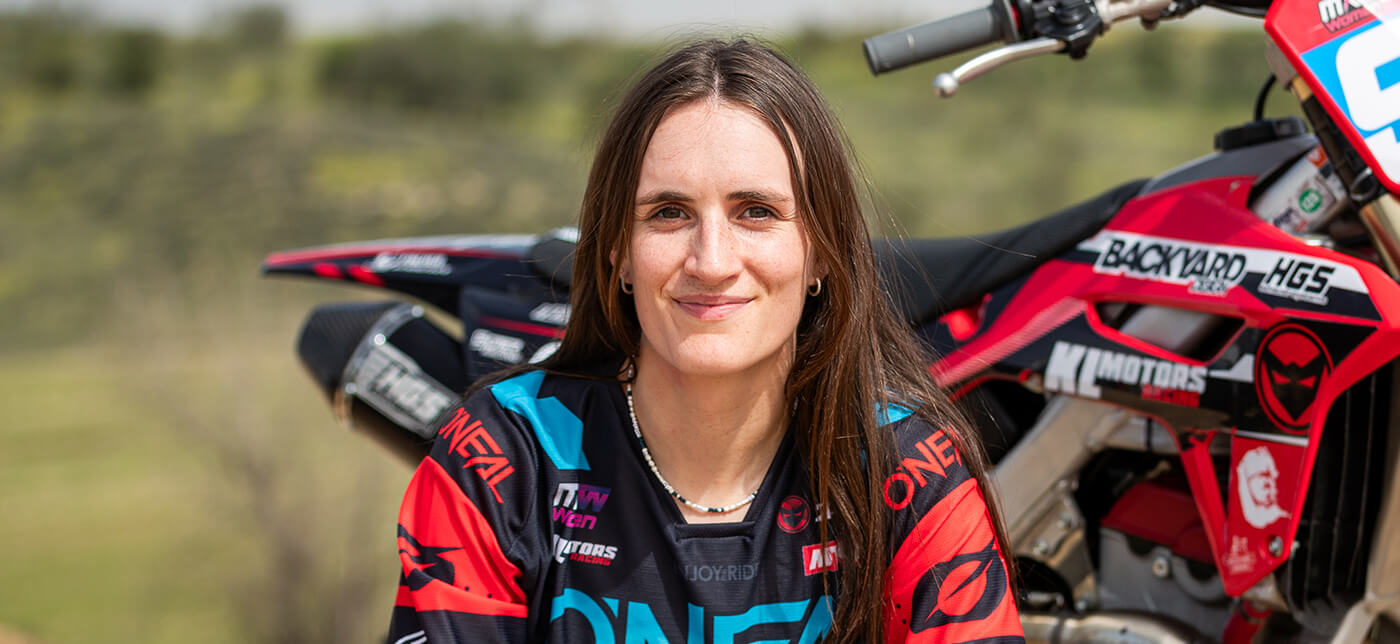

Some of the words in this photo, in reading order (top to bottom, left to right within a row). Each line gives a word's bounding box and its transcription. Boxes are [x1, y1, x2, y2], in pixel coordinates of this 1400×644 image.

[1102, 239, 1247, 282] BACKYARD
[1266, 257, 1336, 295] HGS
[1097, 350, 1208, 395] MOTORS
